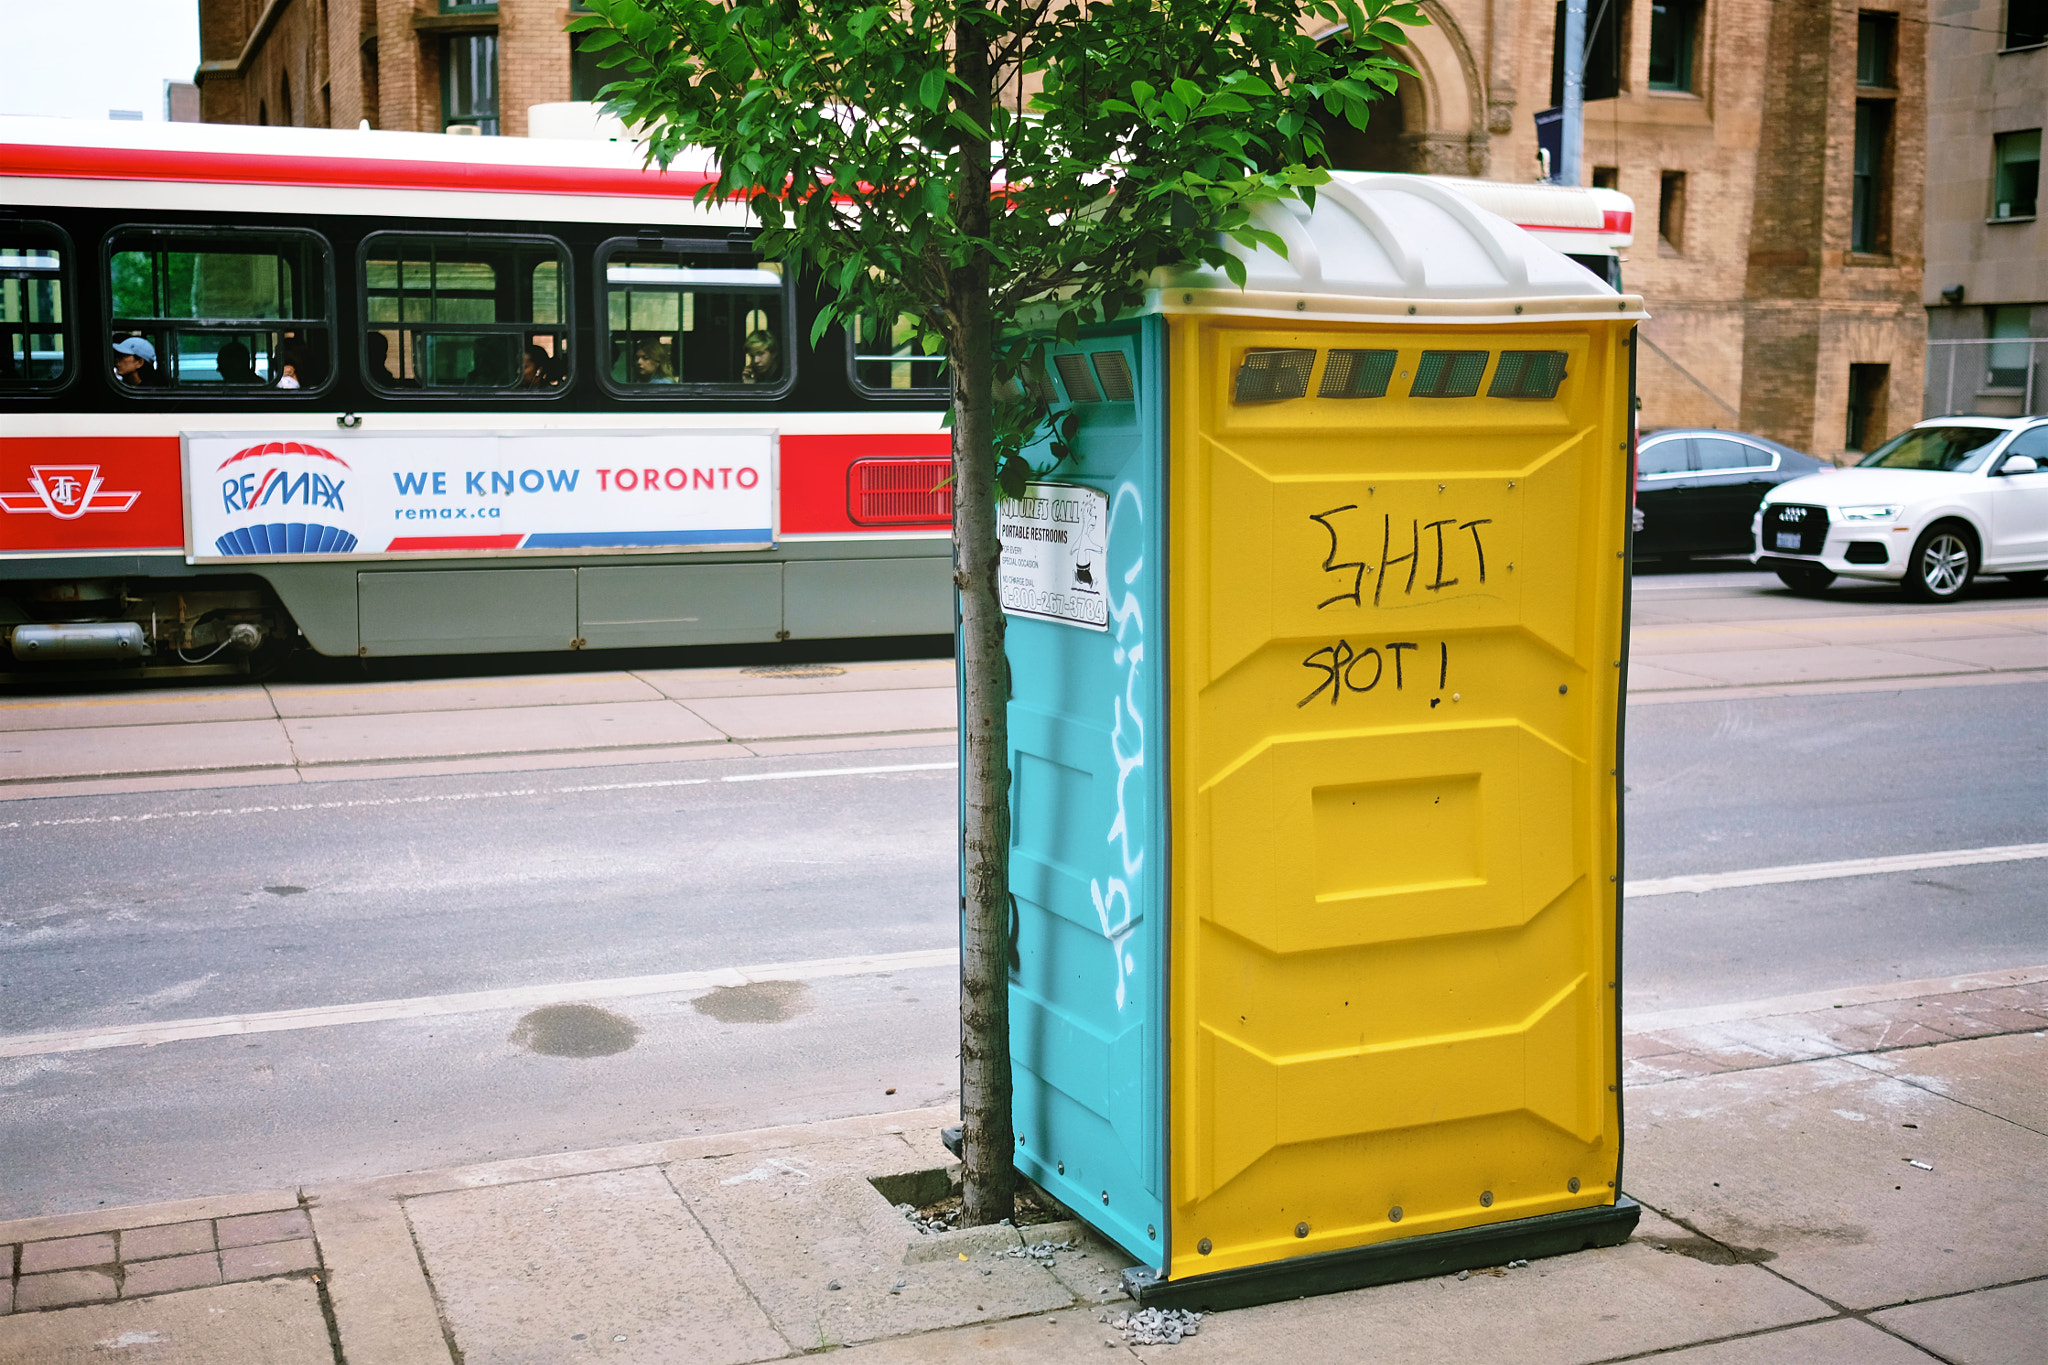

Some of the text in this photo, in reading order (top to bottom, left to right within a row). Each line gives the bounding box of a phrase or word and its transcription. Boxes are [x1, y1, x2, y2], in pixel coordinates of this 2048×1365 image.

[222, 468, 346, 515] RE/MAX
[393, 467, 759, 496] WE KNOW TORONTO
[394, 505, 501, 520] remax.ca
[1051, 499, 1080, 523] CALL
[1002, 524, 1068, 544] PORTABLE RESTROOMS
[1010, 545, 1022, 555] EVERY
[1309, 505, 1493, 610] SHIT
[1002, 556, 1039, 569] SPECIAL OCCASION
[1003, 585, 1105, 623] 1-800-267-3784
